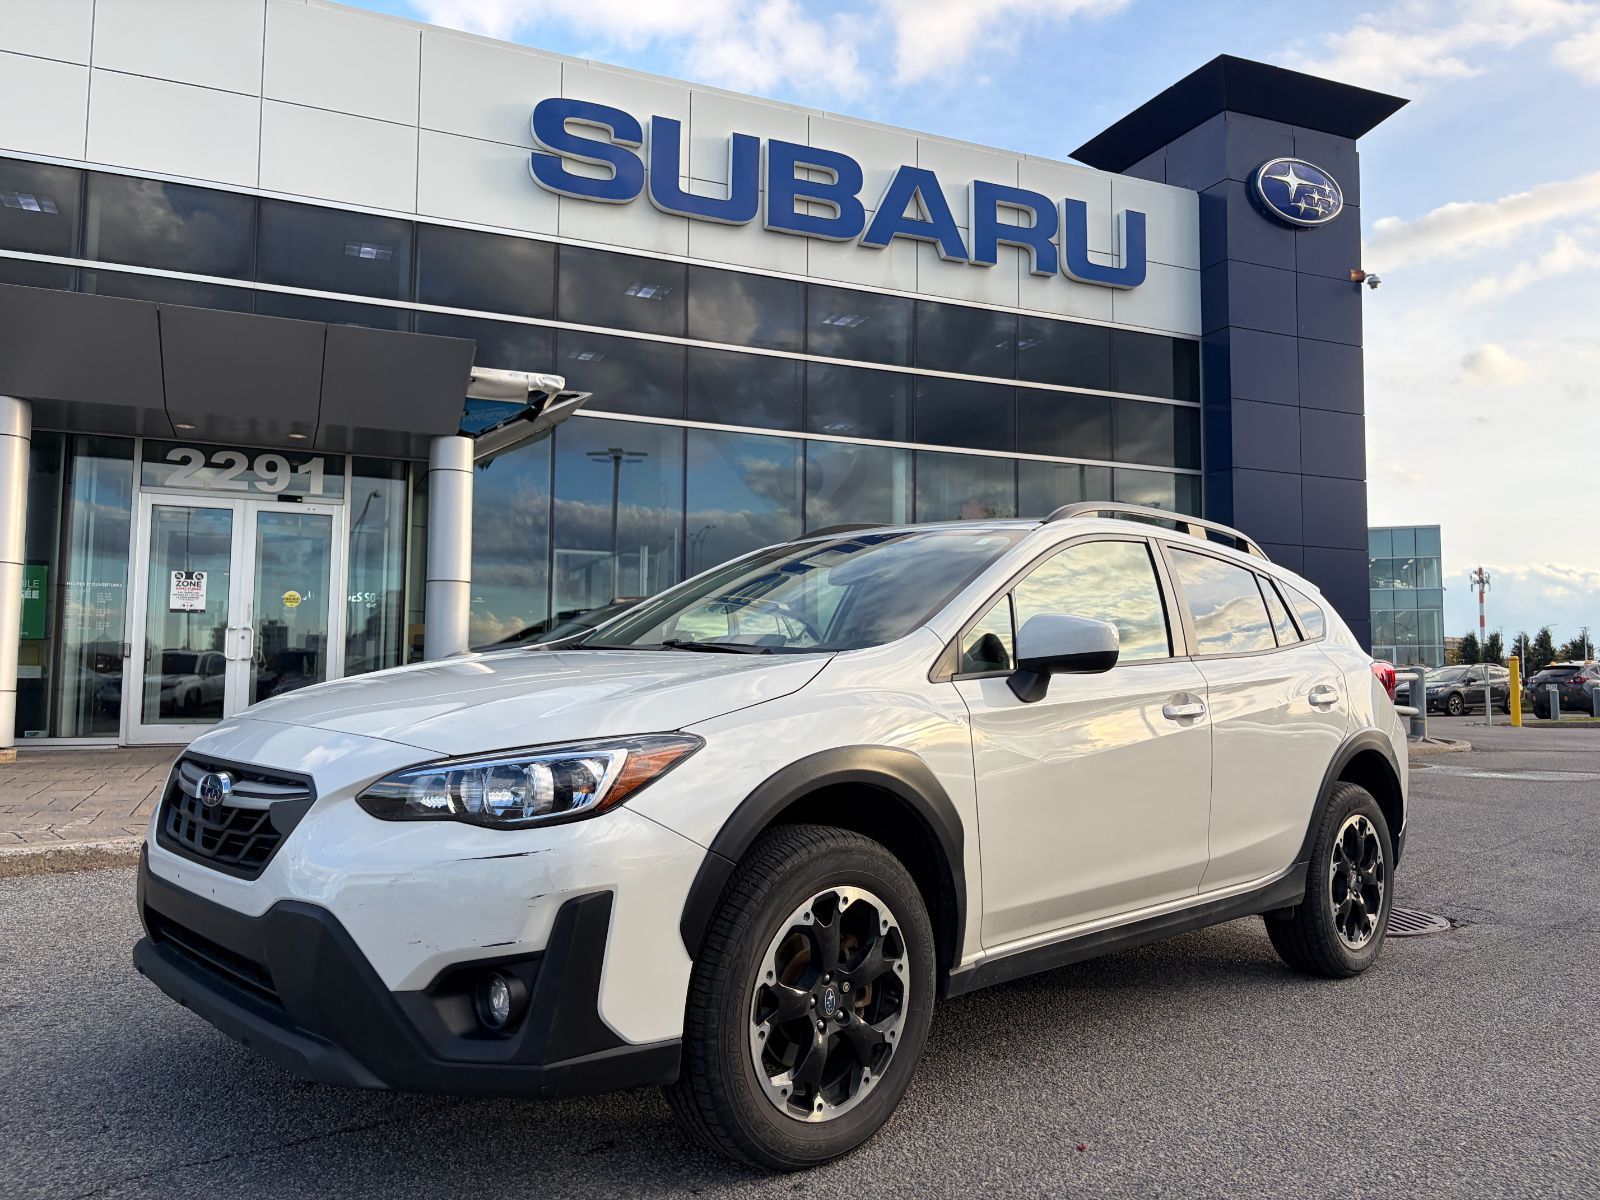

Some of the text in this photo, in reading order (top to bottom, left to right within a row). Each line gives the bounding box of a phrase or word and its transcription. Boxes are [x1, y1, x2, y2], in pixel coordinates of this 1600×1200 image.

[529, 97, 1147, 290] SUBARU
[165, 448, 325, 495] 2291
[175, 580, 203, 588] ZONE
